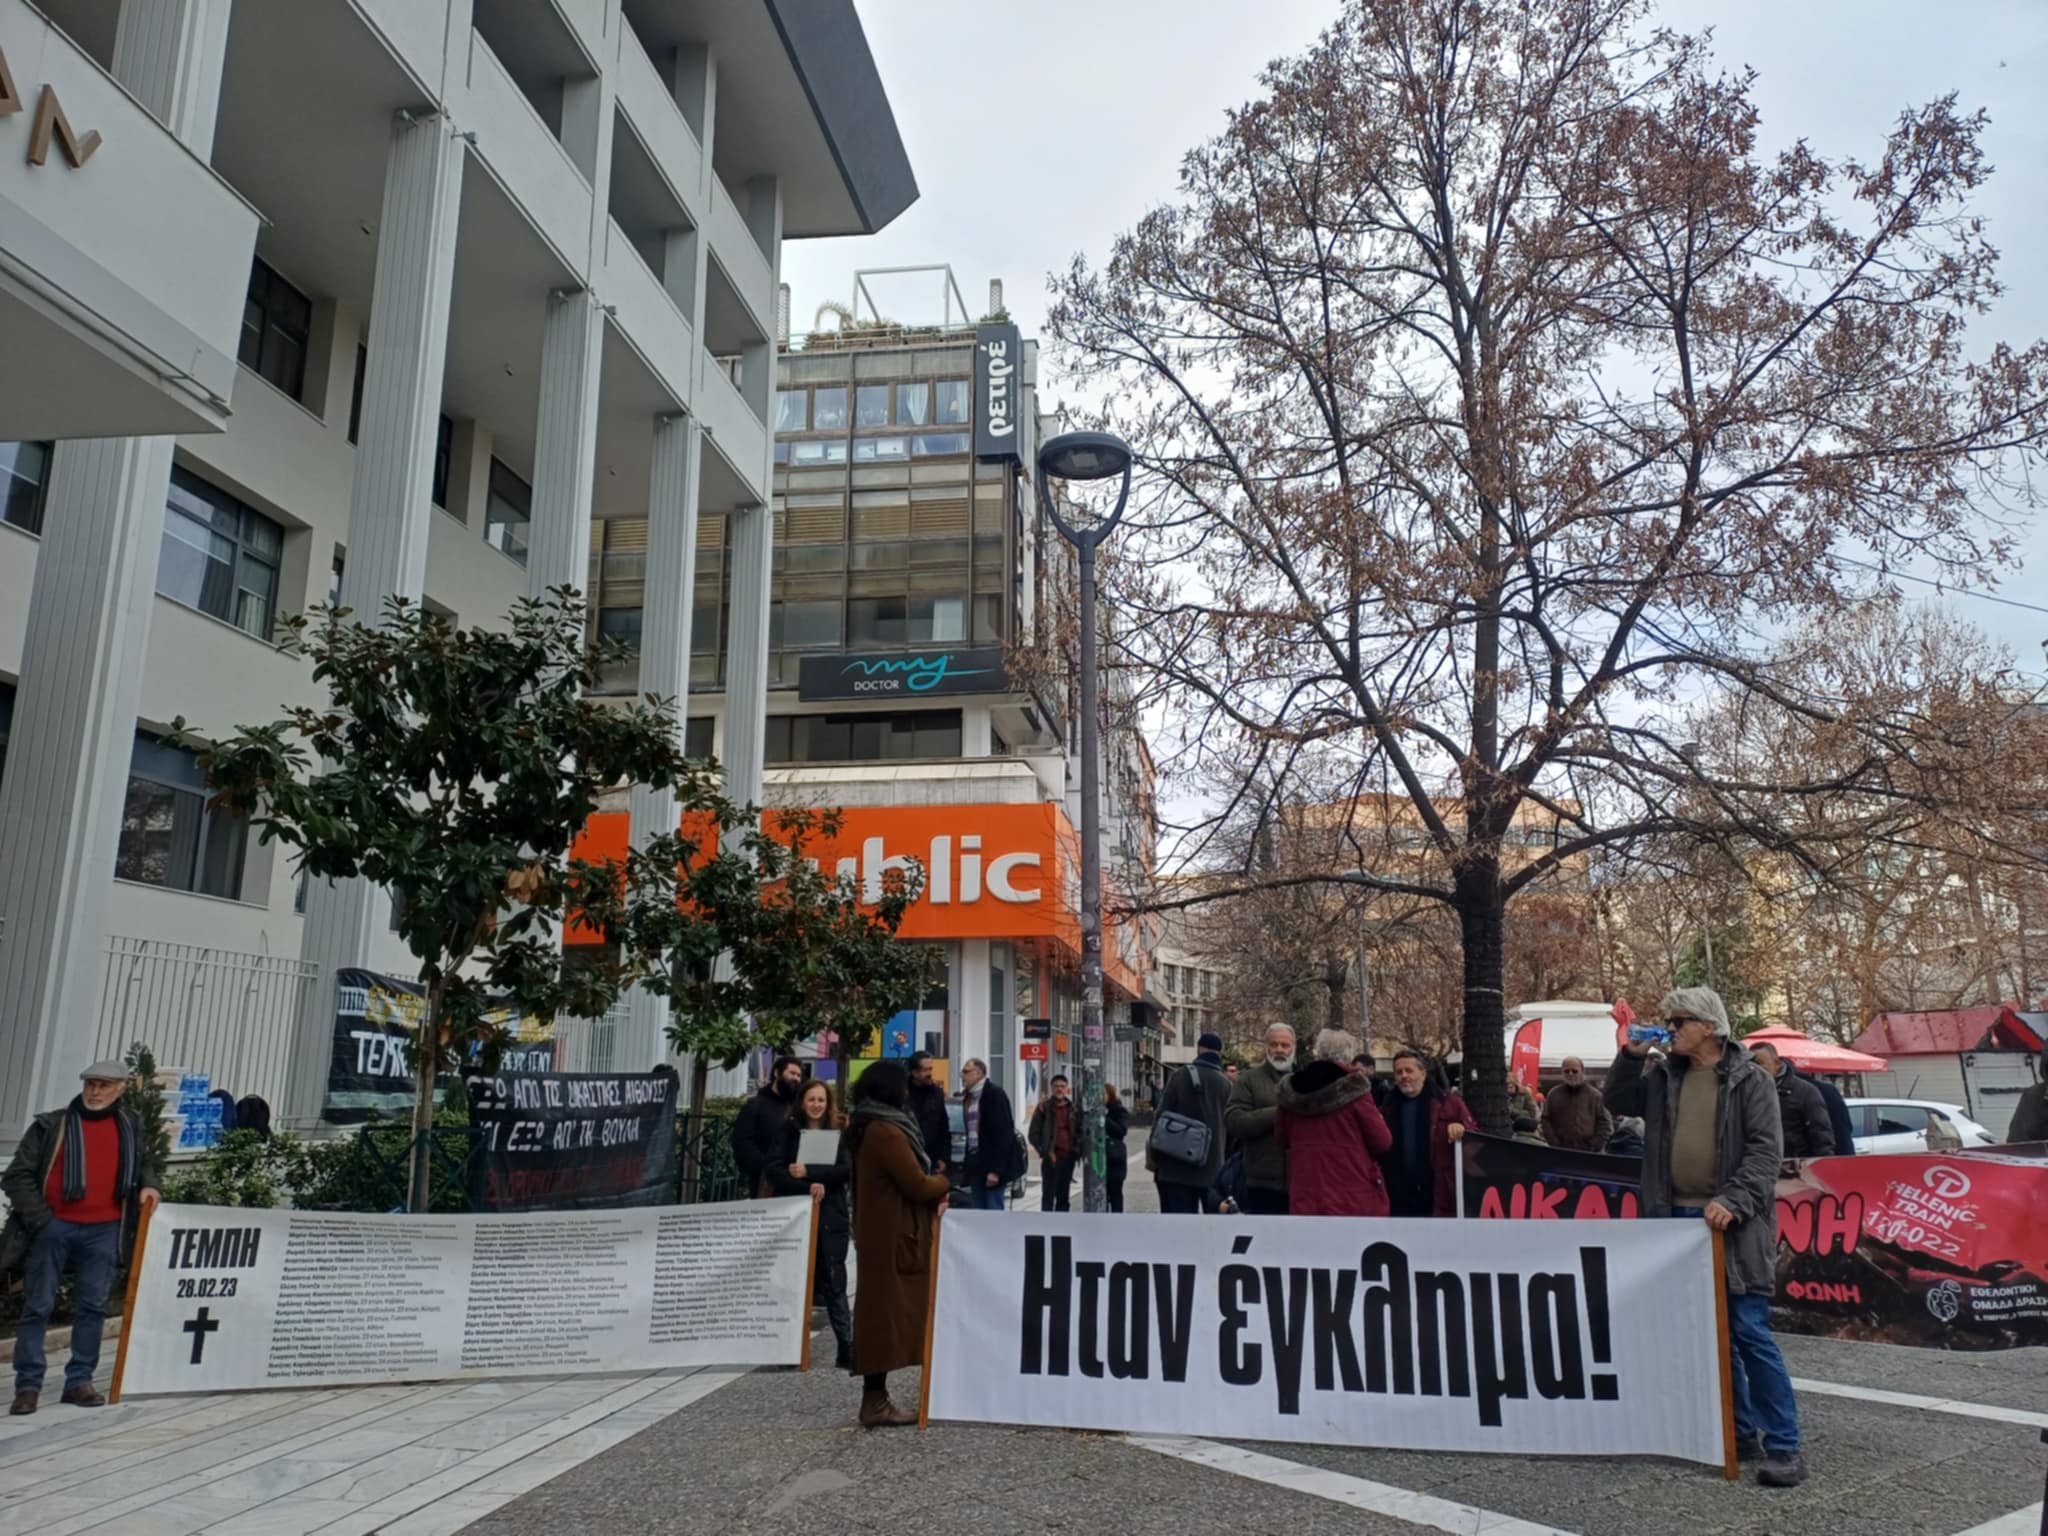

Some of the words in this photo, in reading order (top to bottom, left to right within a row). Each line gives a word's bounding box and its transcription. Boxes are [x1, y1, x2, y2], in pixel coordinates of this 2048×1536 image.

[980, 340, 1014, 437] ρετιρέ
[840, 655, 966, 690] my
[854, 680, 900, 692] DOCTOR
[760, 835, 1041, 905] ublic
[514, 1078, 541, 1109] ΑΠΟ
[543, 1079, 563, 1108] ΤΙΣ
[602, 1117, 641, 1147] ΒΟΥΛΗ
[1888, 1181, 1977, 1222] HELLENIC
[1895, 1198, 1953, 1229] TRAIN
[168, 1228, 261, 1269] ΤΕΜΠΗ
[176, 1278, 238, 1298] 28.02.23
[1786, 1280, 1862, 1304] ΦΩΝΗ
[1970, 1284, 2037, 1297] ΕΘΕΛΟΝΤΙΚΗ
[1972, 1299, 2014, 1310] ΟΜΑΔΑ
[1019, 1234, 1196, 1383] Ηταν
[1218, 1234, 1620, 1427] έγκλημα!
